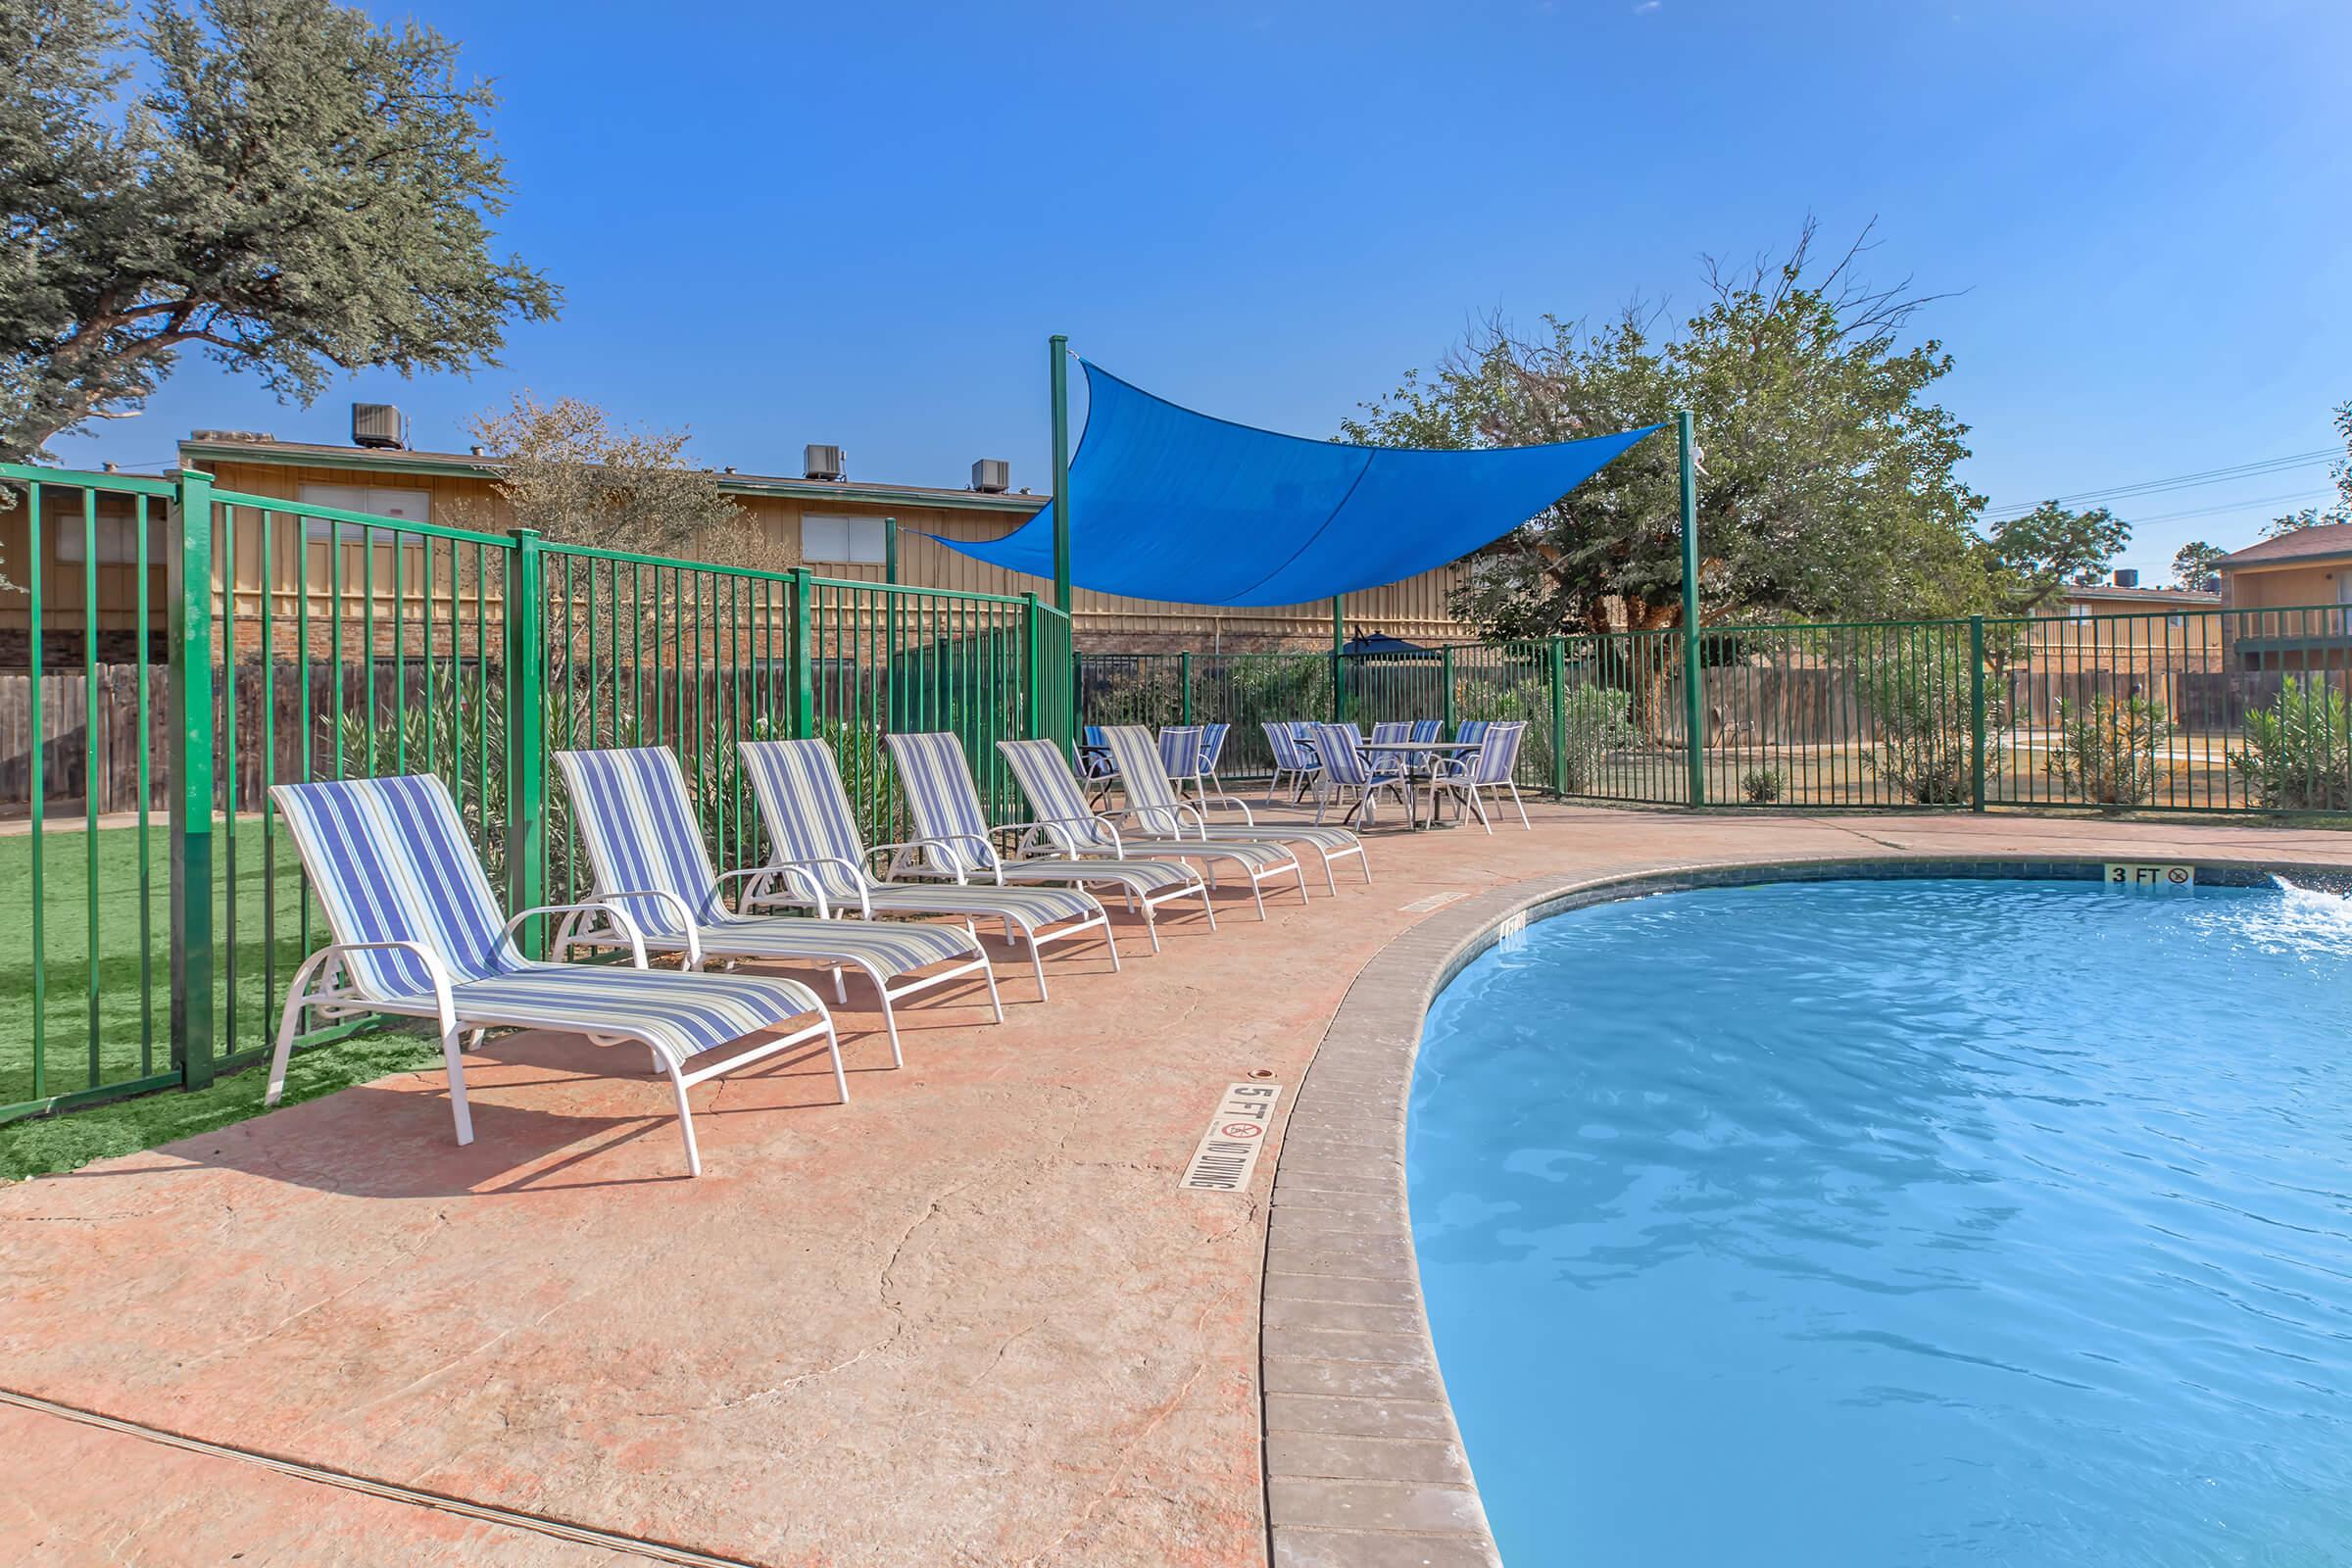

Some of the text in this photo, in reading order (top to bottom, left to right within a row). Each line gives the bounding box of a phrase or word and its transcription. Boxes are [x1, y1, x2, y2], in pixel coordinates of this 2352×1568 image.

[2112, 867, 2161, 884] 3 FT
[1224, 1087, 1274, 1119] 5 FT
[1189, 1140, 1253, 1189] NO DIVING
